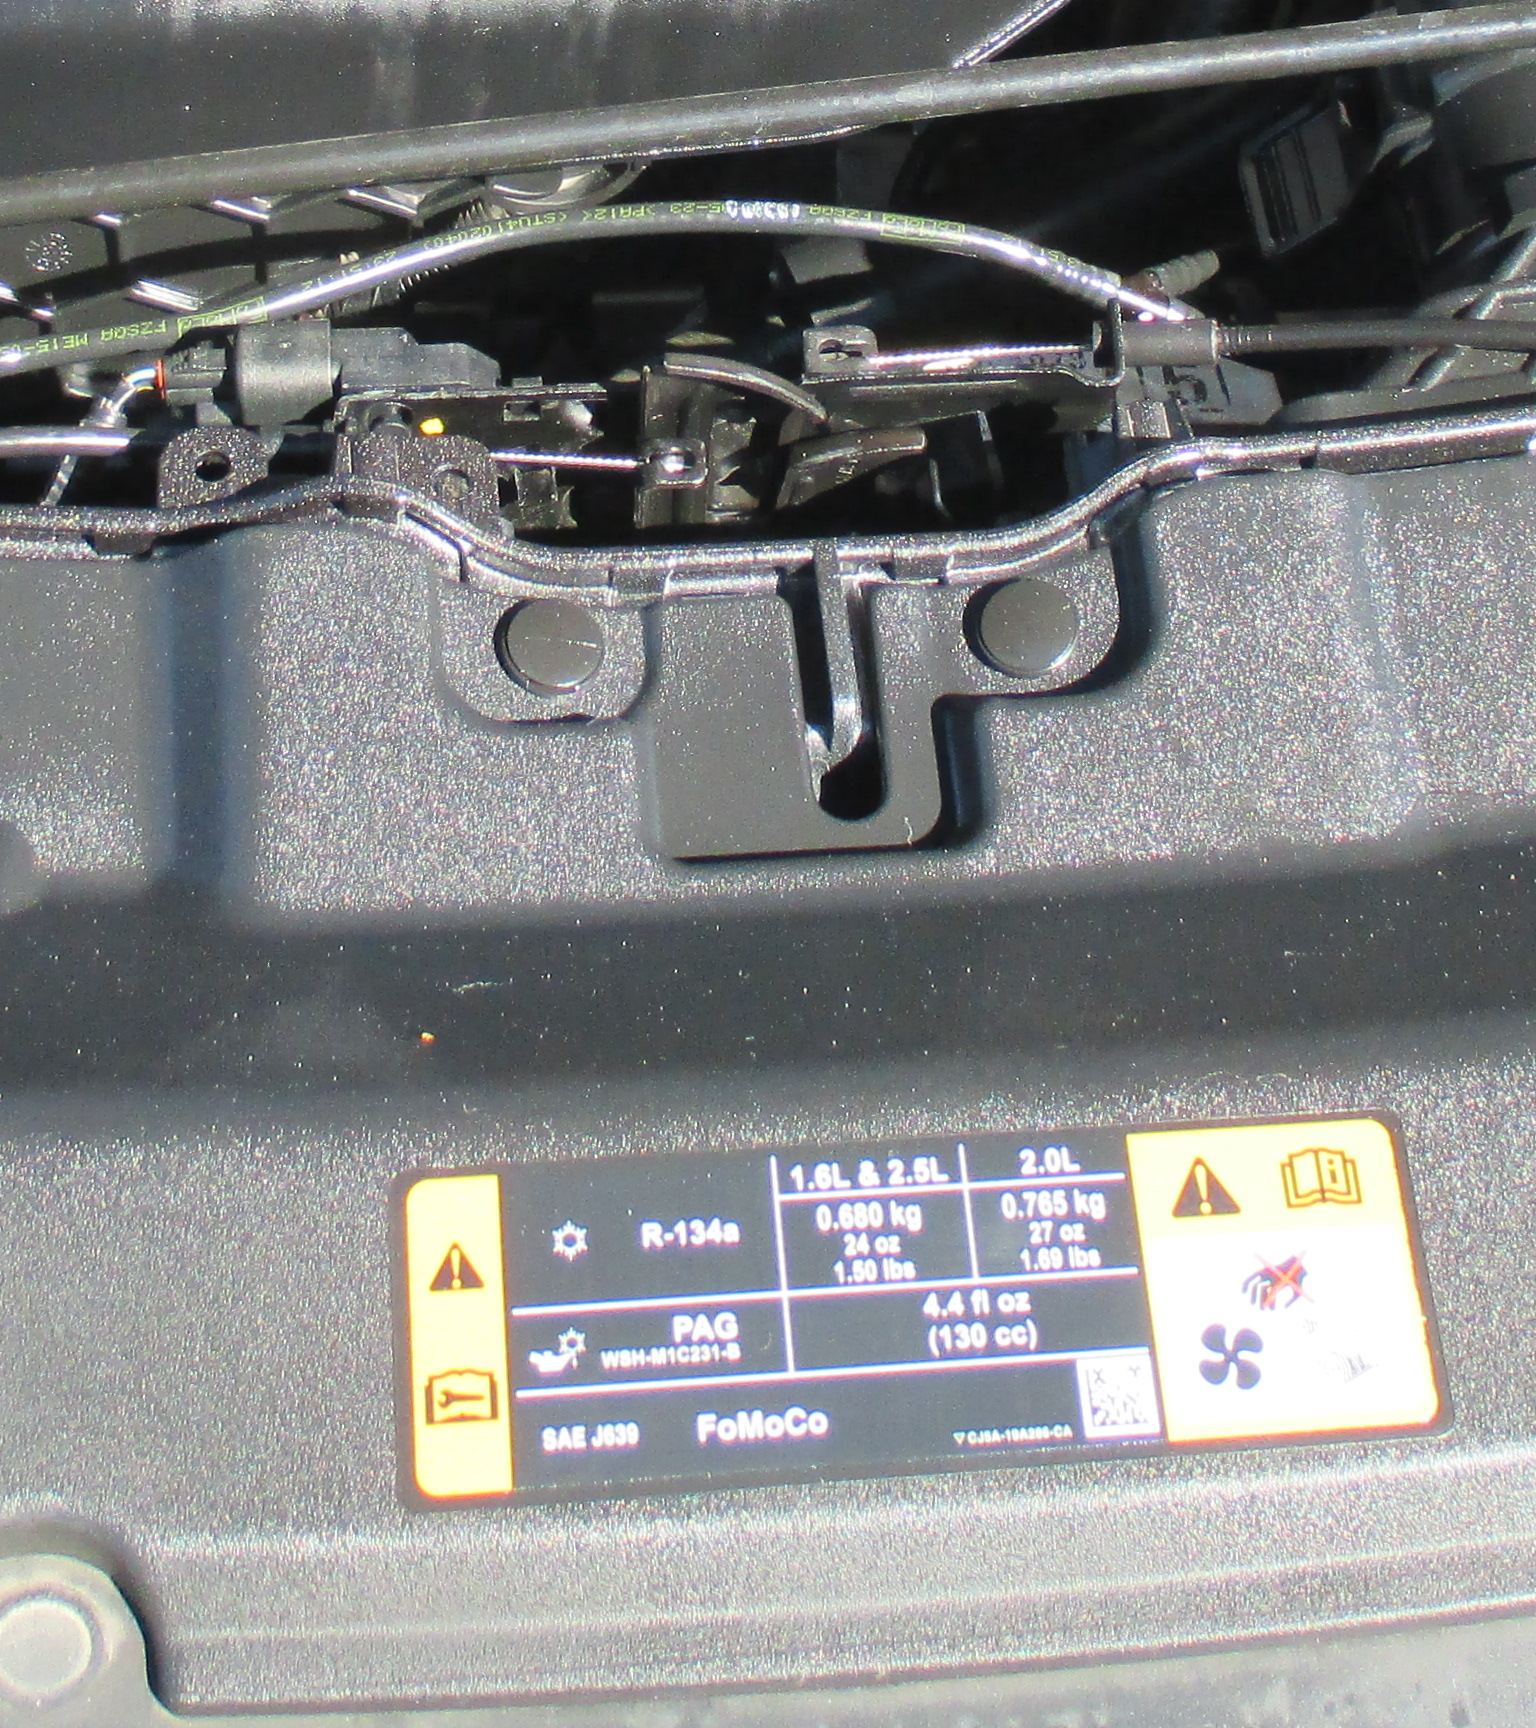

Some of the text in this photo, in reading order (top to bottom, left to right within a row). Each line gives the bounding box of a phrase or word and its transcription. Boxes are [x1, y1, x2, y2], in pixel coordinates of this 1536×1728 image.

[790, 1156, 949, 1191] 1.6L & 2.5L
[1019, 1146, 1081, 1175] 2.0L
[816, 1200, 922, 1232] 0.680 kg
[1001, 1188, 1106, 1221] 0.765 kg
[641, 1217, 741, 1250] R-134a
[844, 1233, 901, 1258] 24 oz
[1029, 1221, 1085, 1245] 27 oz
[833, 1257, 916, 1285] 1.50 lbs
[1020, 1245, 1101, 1272] 1.69 lbs
[923, 1288, 1031, 1319] 4.4 fl oz
[672, 1311, 739, 1344] PAG
[929, 1318, 1038, 1357] (130 cc)
[600, 1342, 742, 1370] WSH-M1C231-B
[542, 1421, 640, 1453] SAE J639
[696, 1406, 830, 1445] FoMoCo
